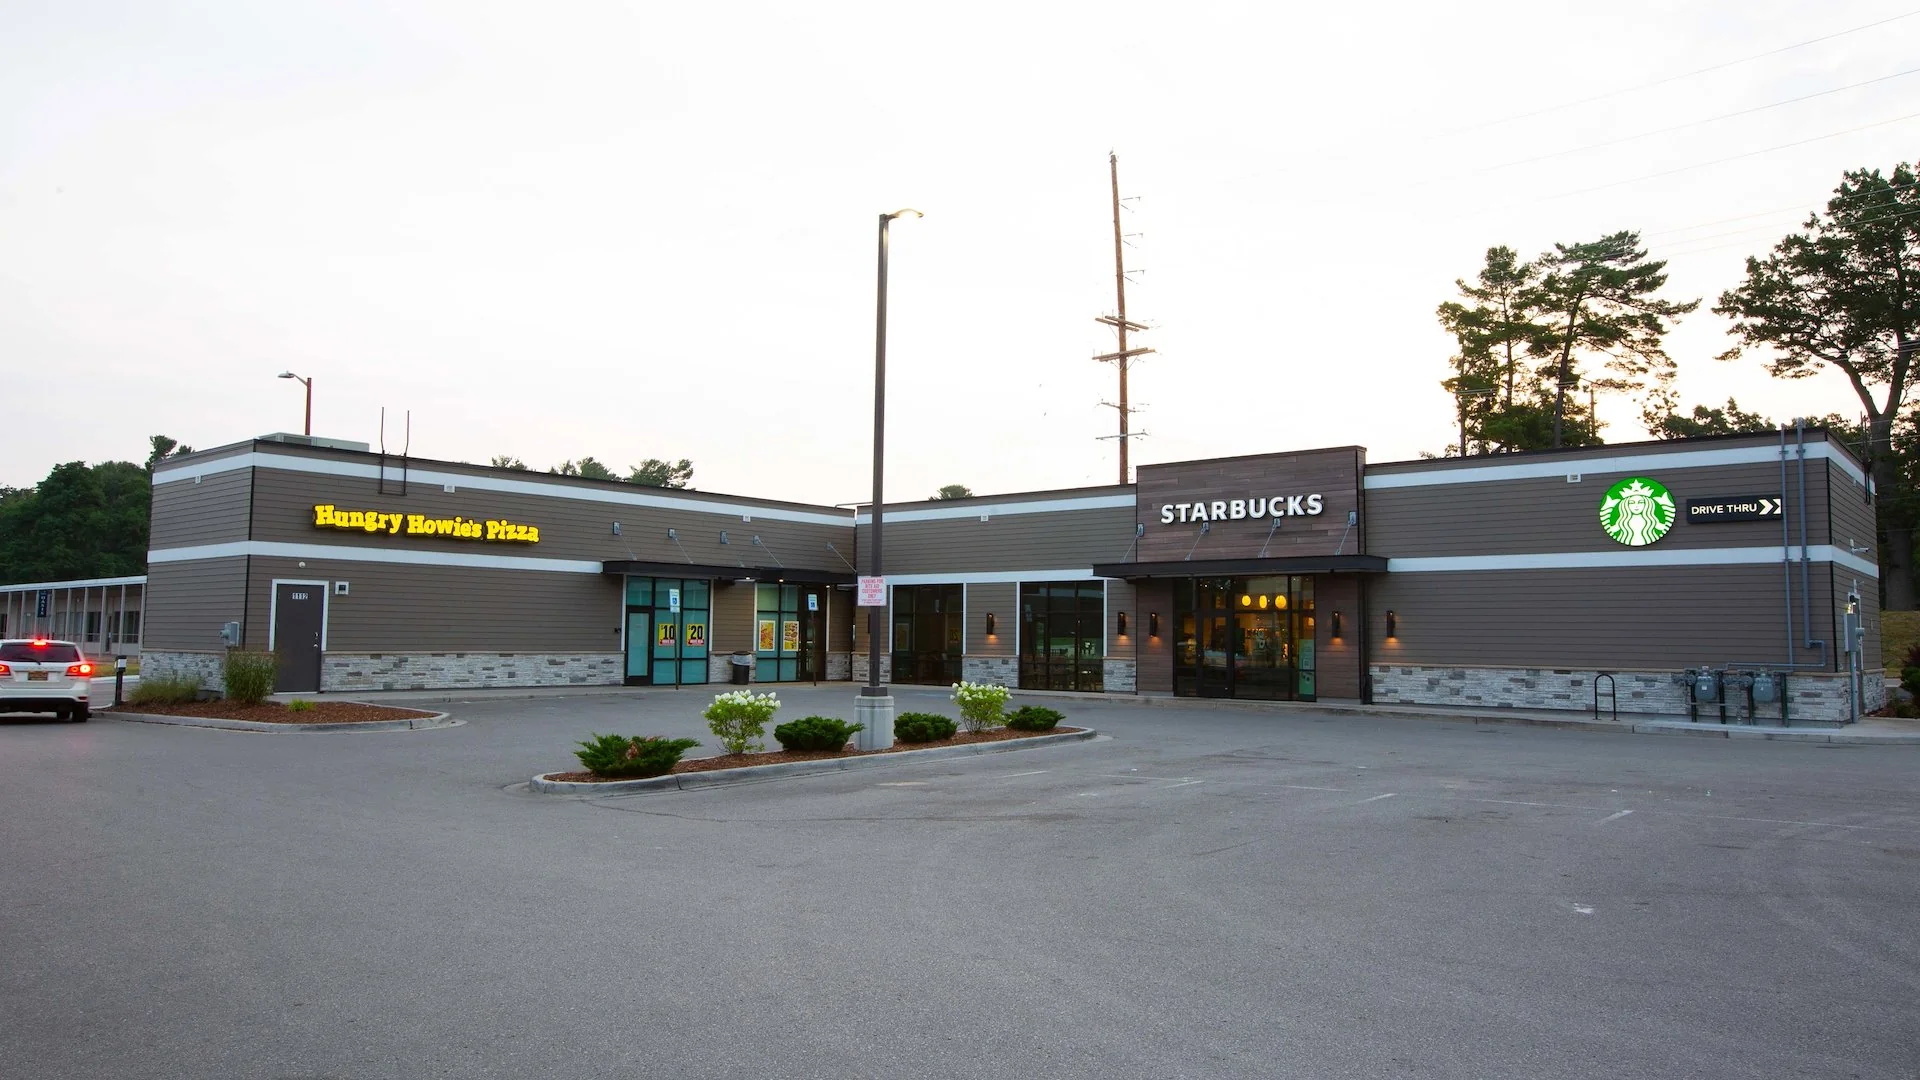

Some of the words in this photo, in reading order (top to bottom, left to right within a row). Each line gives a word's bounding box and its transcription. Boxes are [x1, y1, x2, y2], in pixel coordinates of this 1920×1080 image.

[314, 504, 403, 534] Hungry
[407, 516, 482, 538] Howie's
[486, 519, 540, 543] Pizza
[1160, 494, 1324, 525] STARBUCKS
[1691, 505, 1724, 515] DRIVE
[1726, 503, 1758, 513] THRU
